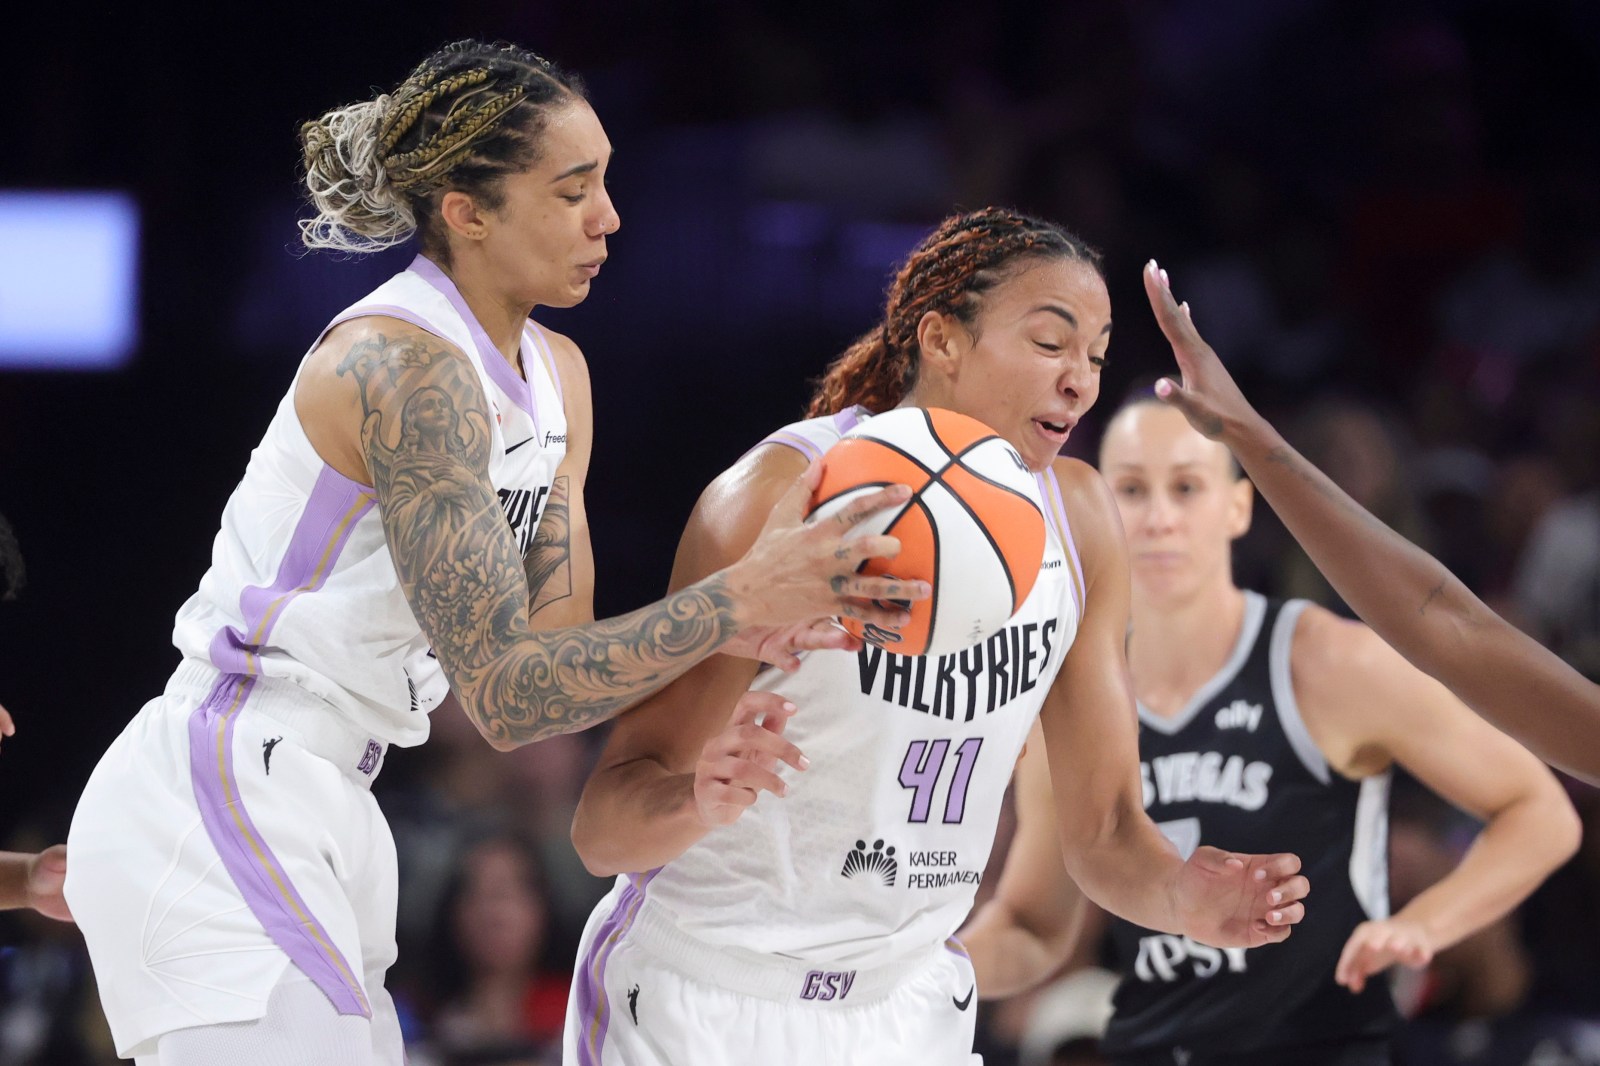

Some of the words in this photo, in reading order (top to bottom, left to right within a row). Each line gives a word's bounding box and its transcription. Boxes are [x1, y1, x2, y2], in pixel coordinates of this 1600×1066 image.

[544, 430, 566, 448] freed
[858, 618, 1057, 723] VALKYRIES
[357, 738, 382, 777] GS
[897, 737, 984, 824] 41
[1152, 751, 1273, 811] VEGAS
[909, 851, 957, 867] KAISER
[907, 870, 984, 889] PERMANEN
[799, 970, 856, 1001] GSV
